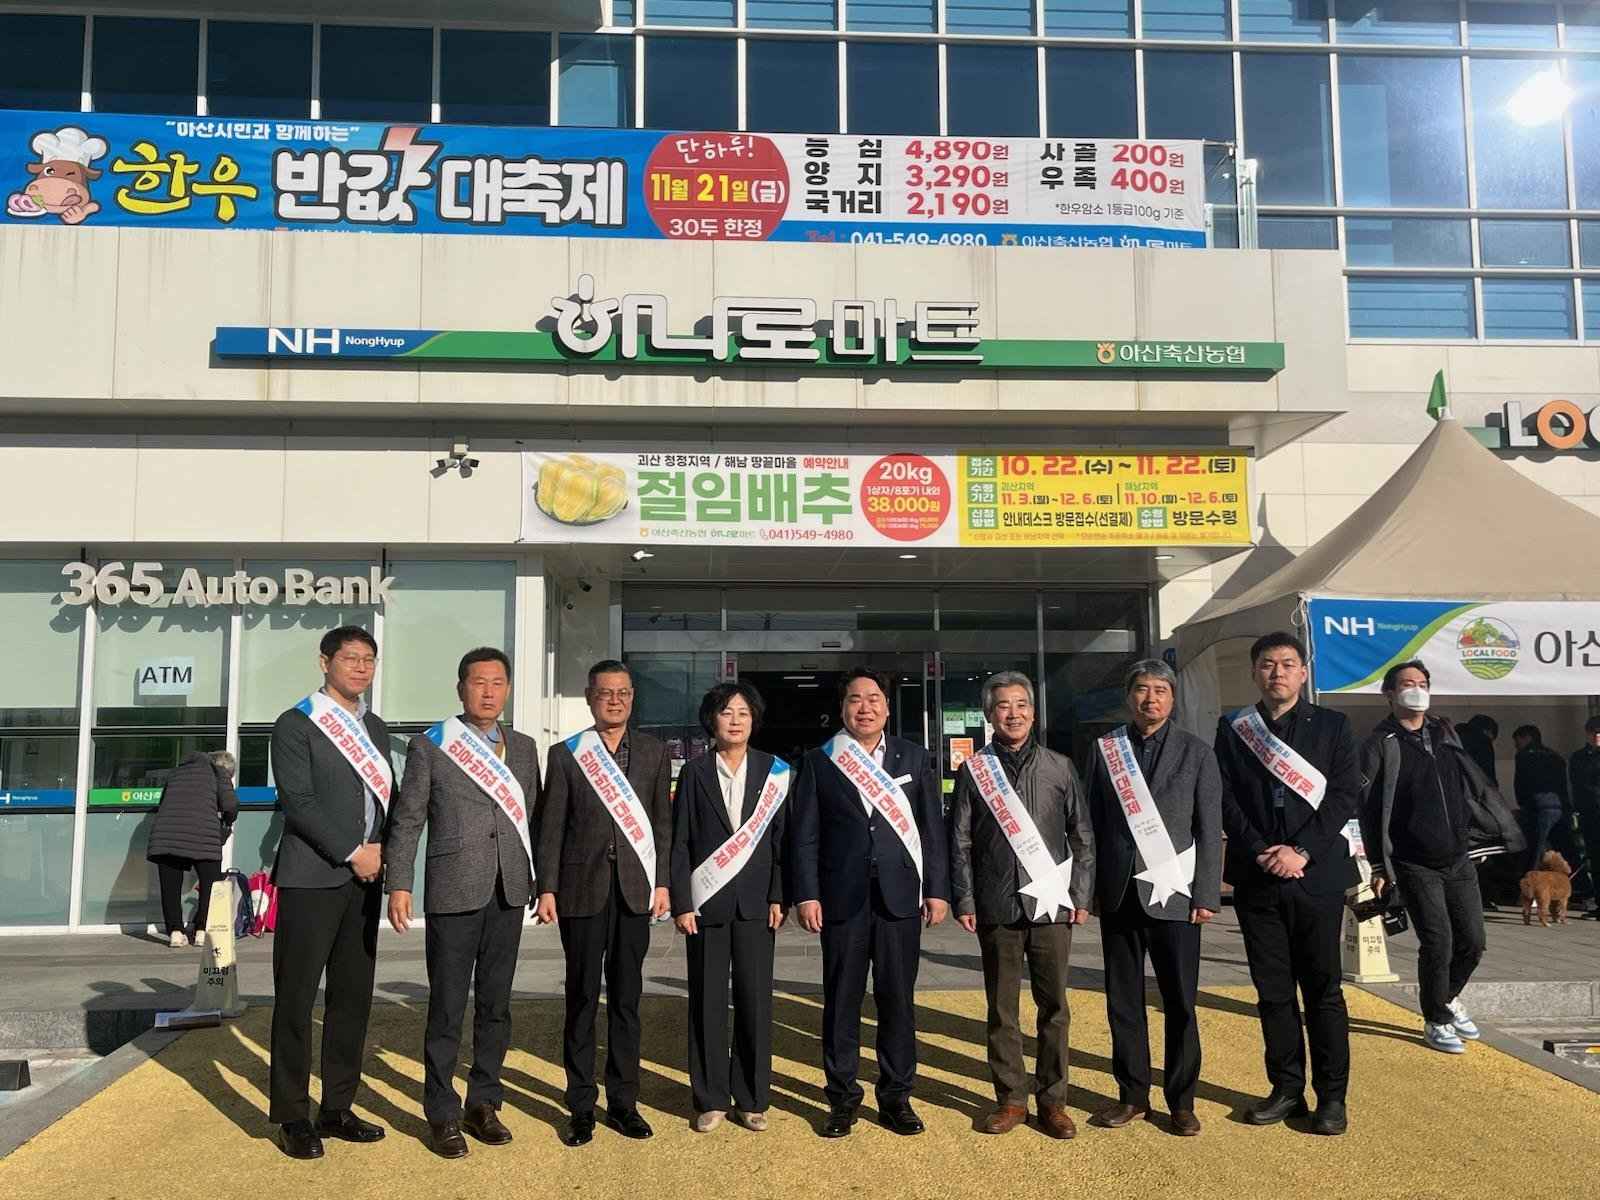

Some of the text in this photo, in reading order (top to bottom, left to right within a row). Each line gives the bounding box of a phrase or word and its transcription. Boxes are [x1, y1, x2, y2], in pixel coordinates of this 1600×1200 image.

[905, 140, 1009, 163] 4,890원
[1112, 143, 1184, 168] 200원
[111, 126, 625, 226] 한우 반값 대축제
[650, 172, 689, 202] 11월
[905, 165, 1009, 190] 3,290원
[1110, 168, 1185, 195] 400원
[805, 189, 1009, 219] 국거리 2,190원
[1164, 207, 1185, 221] 기준
[669, 217, 763, 238] 30두 한정
[850, 231, 988, 246] 041-549-4980
[551, 274, 984, 363] 하나로마트
[267, 328, 405, 354] NH NongHyup
[1119, 344, 1245, 364] 아산축산농협
[1503, 400, 1600, 449] LO
[637, 454, 661, 467] 괴산
[664, 454, 711, 468] 청정지역
[724, 455, 748, 468] 해남
[803, 456, 849, 470] 예약안내
[879, 461, 933, 485] 20kg
[637, 471, 853, 525] 절임배추
[1003, 511, 1052, 527] 안내데스크
[1173, 510, 1238, 526] 방문수령
[61, 562, 396, 606] 365 Auto Bank
[1324, 616, 1376, 636] NH
[1461, 648, 1517, 657] LOCAL FOOD
[141, 665, 193, 684] ATM
